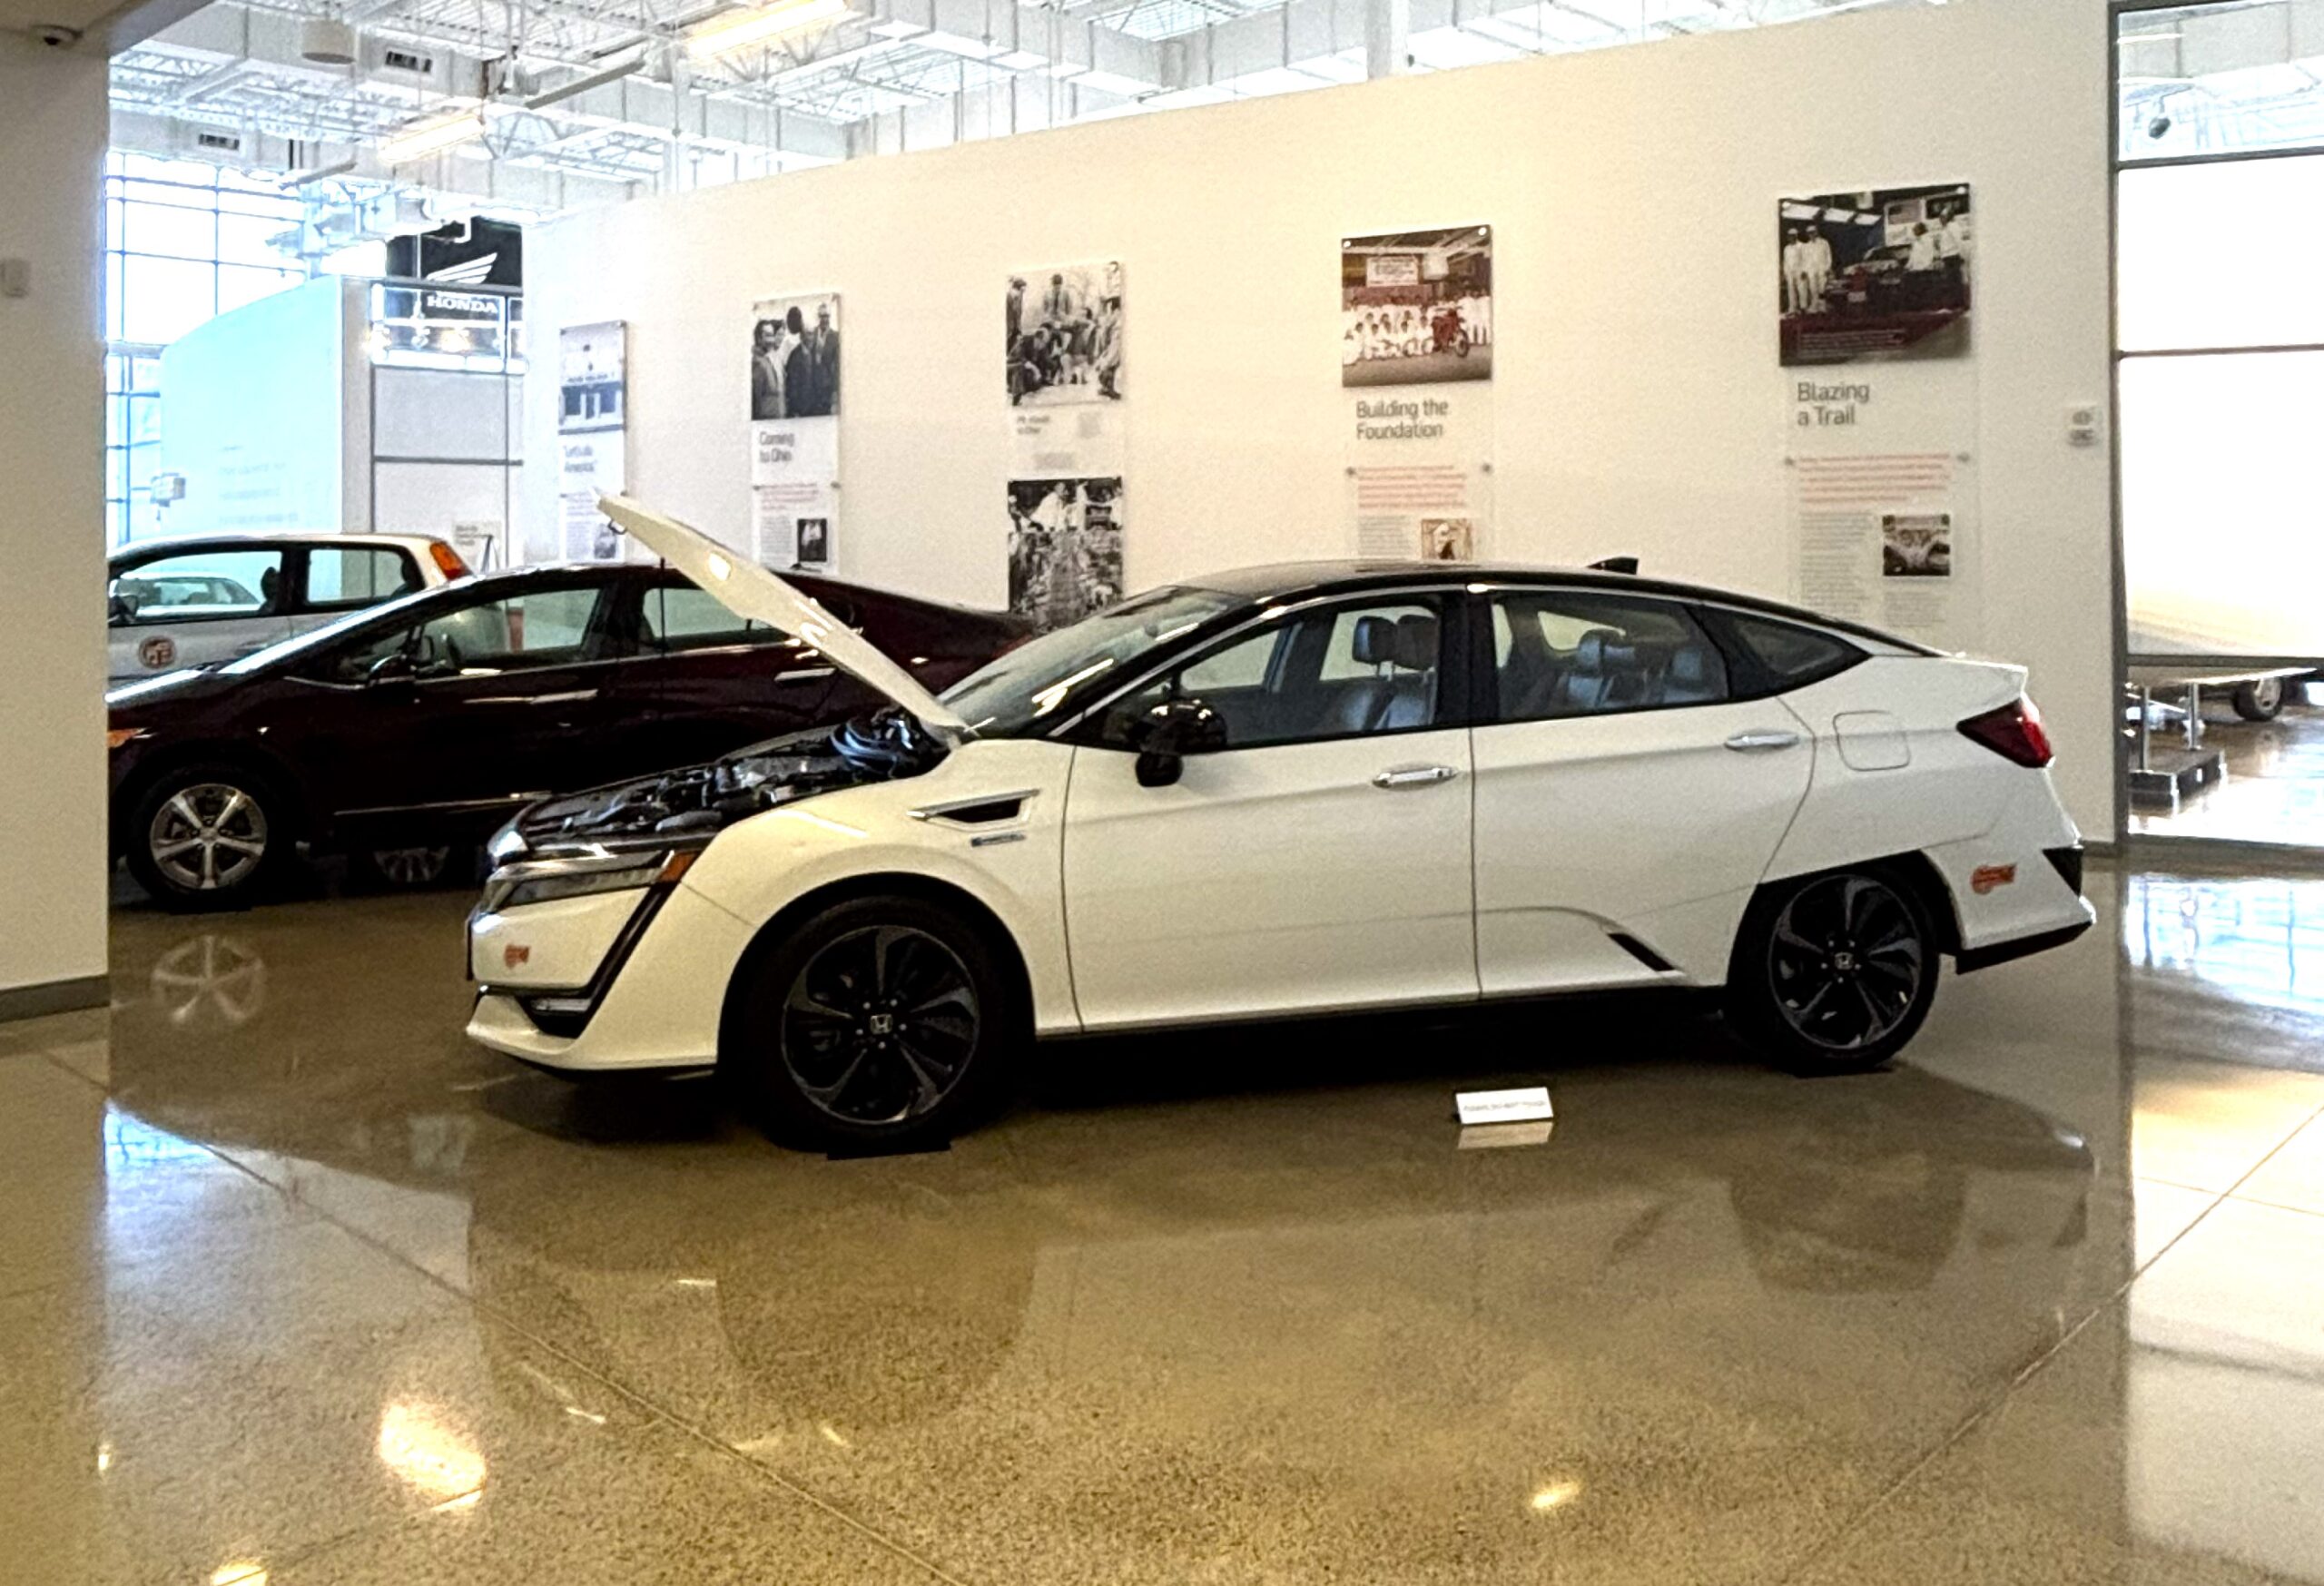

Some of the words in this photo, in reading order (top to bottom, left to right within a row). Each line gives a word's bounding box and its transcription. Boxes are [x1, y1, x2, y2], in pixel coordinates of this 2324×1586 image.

[427, 295, 498, 314] HONDA
[1797, 382, 1870, 404] Blazing
[1356, 399, 1418, 420] Building
[1423, 399, 1449, 417] the
[1797, 411, 1809, 427] a
[1813, 406, 1855, 425] Trail
[1356, 422, 1443, 439] Foundation
